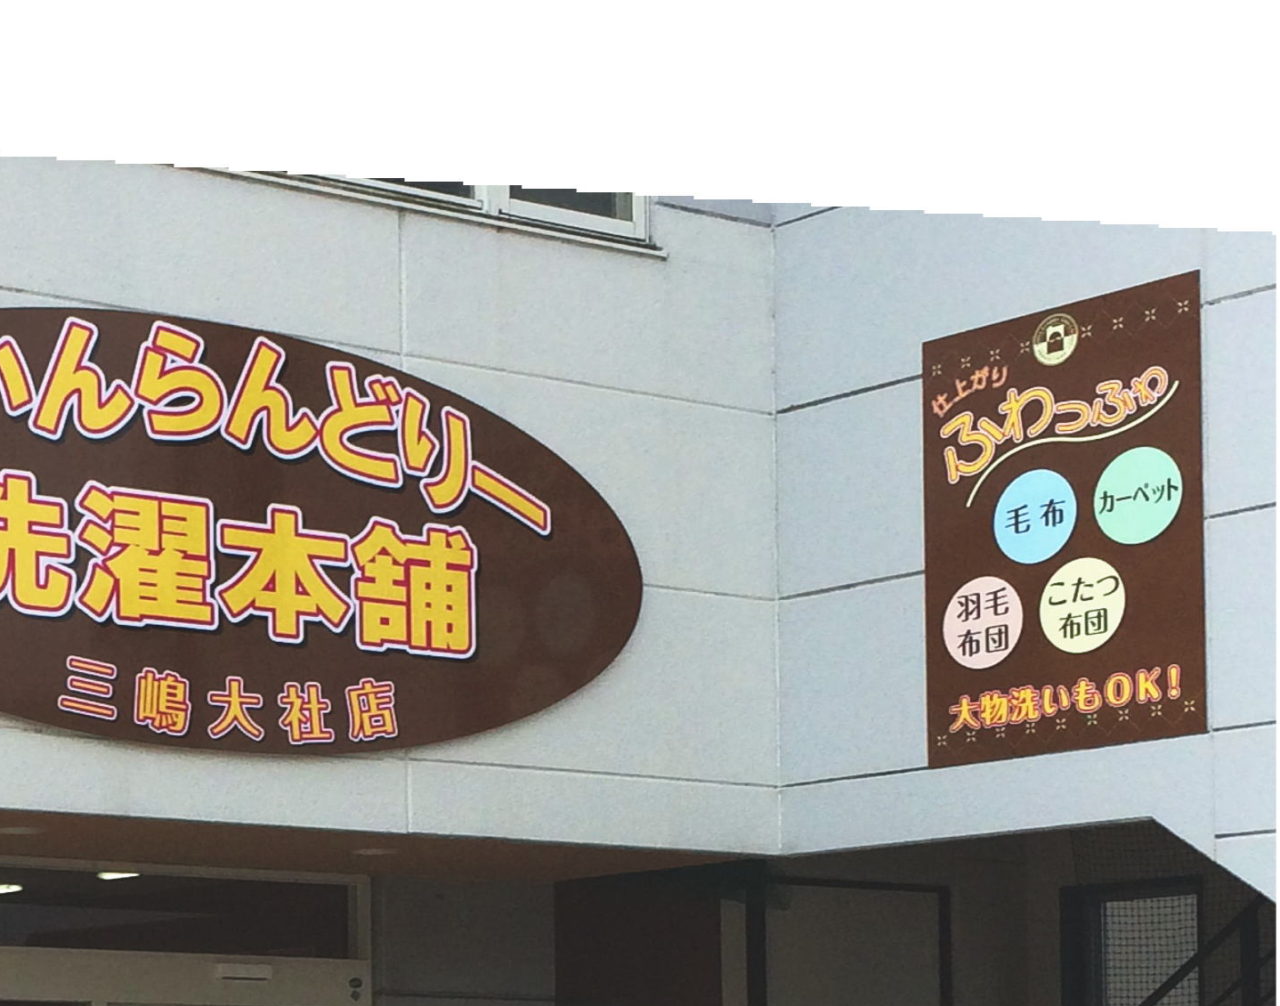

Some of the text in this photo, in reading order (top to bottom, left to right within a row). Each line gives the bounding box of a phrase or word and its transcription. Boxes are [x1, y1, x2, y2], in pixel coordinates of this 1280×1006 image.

[931, 366, 1009, 417] 仕上がり
[1099, 478, 1180, 515] カーペット
[1004, 498, 1066, 535] 毛布
[956, 587, 1010, 622] 羽毛
[1047, 572, 1120, 606] こたつ
[1059, 608, 1108, 639] 布団
[956, 625, 1010, 659] 布団
[58, 655, 398, 743] 三嶋大社店
